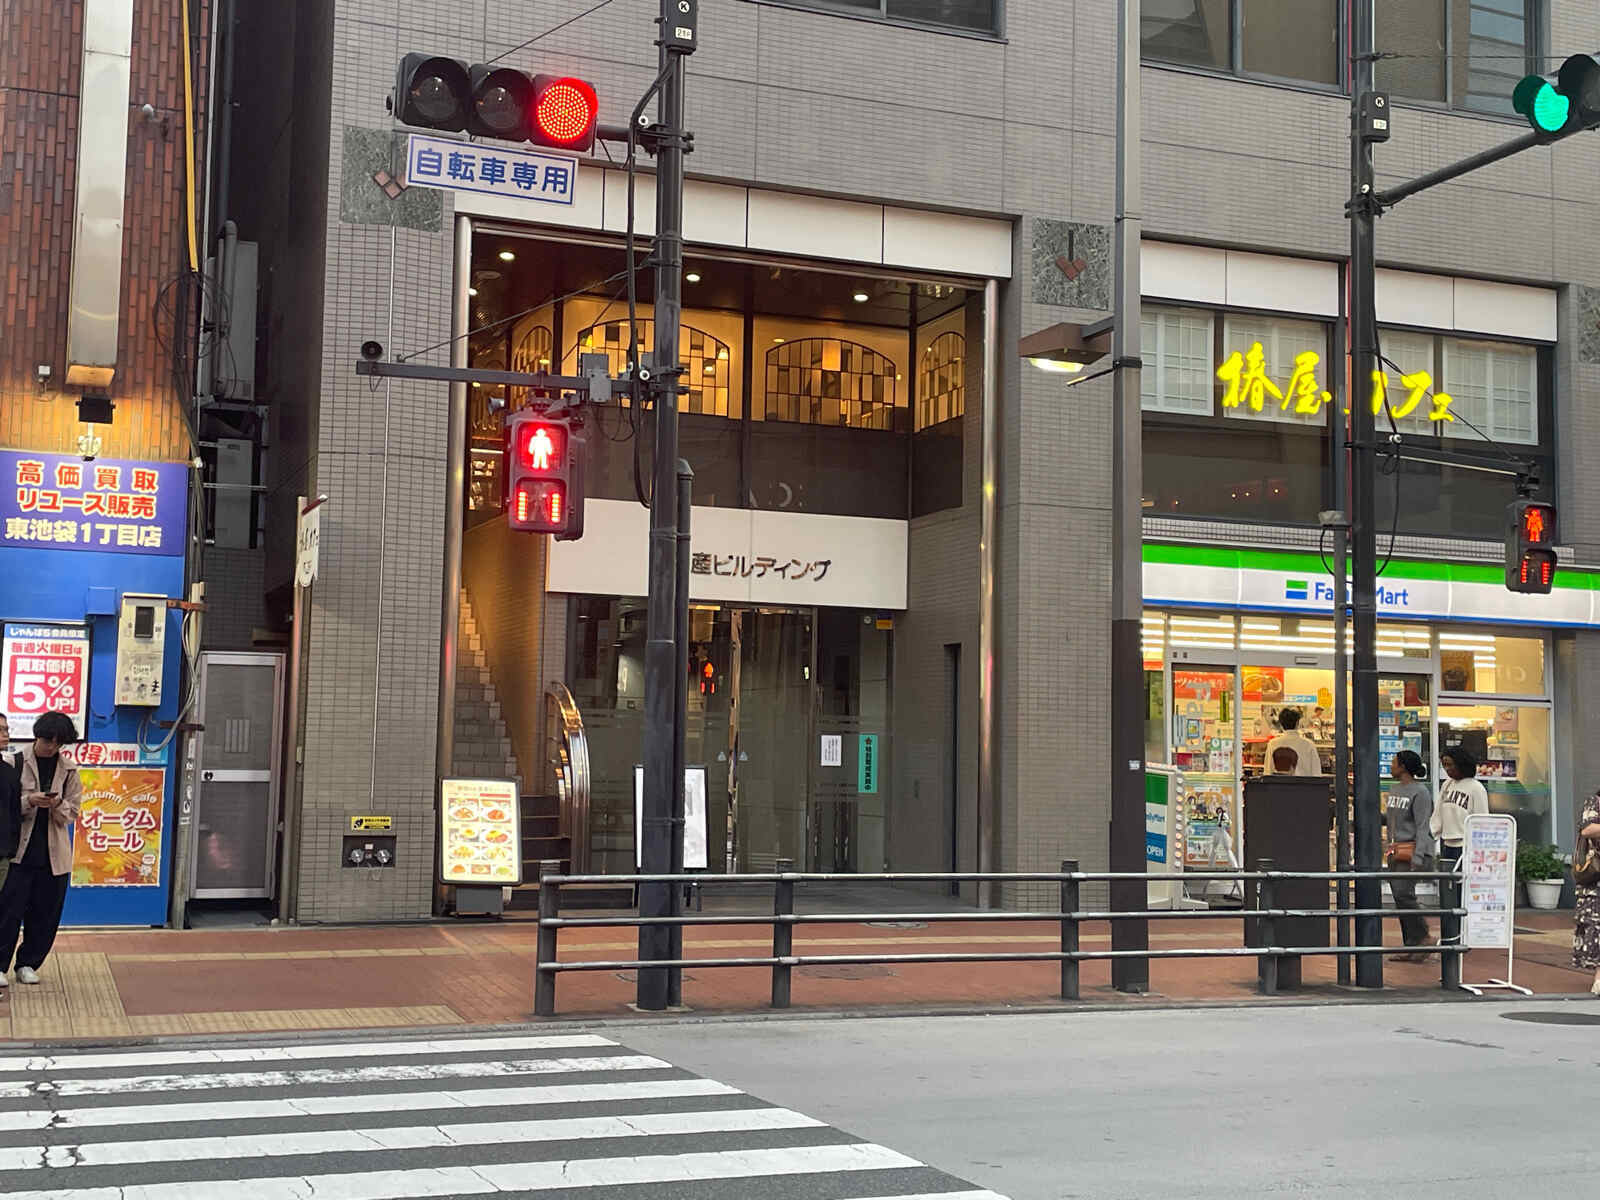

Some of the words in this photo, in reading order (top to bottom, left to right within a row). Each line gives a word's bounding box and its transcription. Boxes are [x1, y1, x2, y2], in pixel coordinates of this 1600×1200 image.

[416, 148, 569, 194] 自転車専用
[17, 460, 159, 493] 高価買取
[5, 517, 162, 548] 東池袋1丁目店
[13, 673, 74, 710] 5%
[46, 697, 75, 711] UP!
[83, 808, 155, 830] オータム
[89, 832, 143, 850] セール
